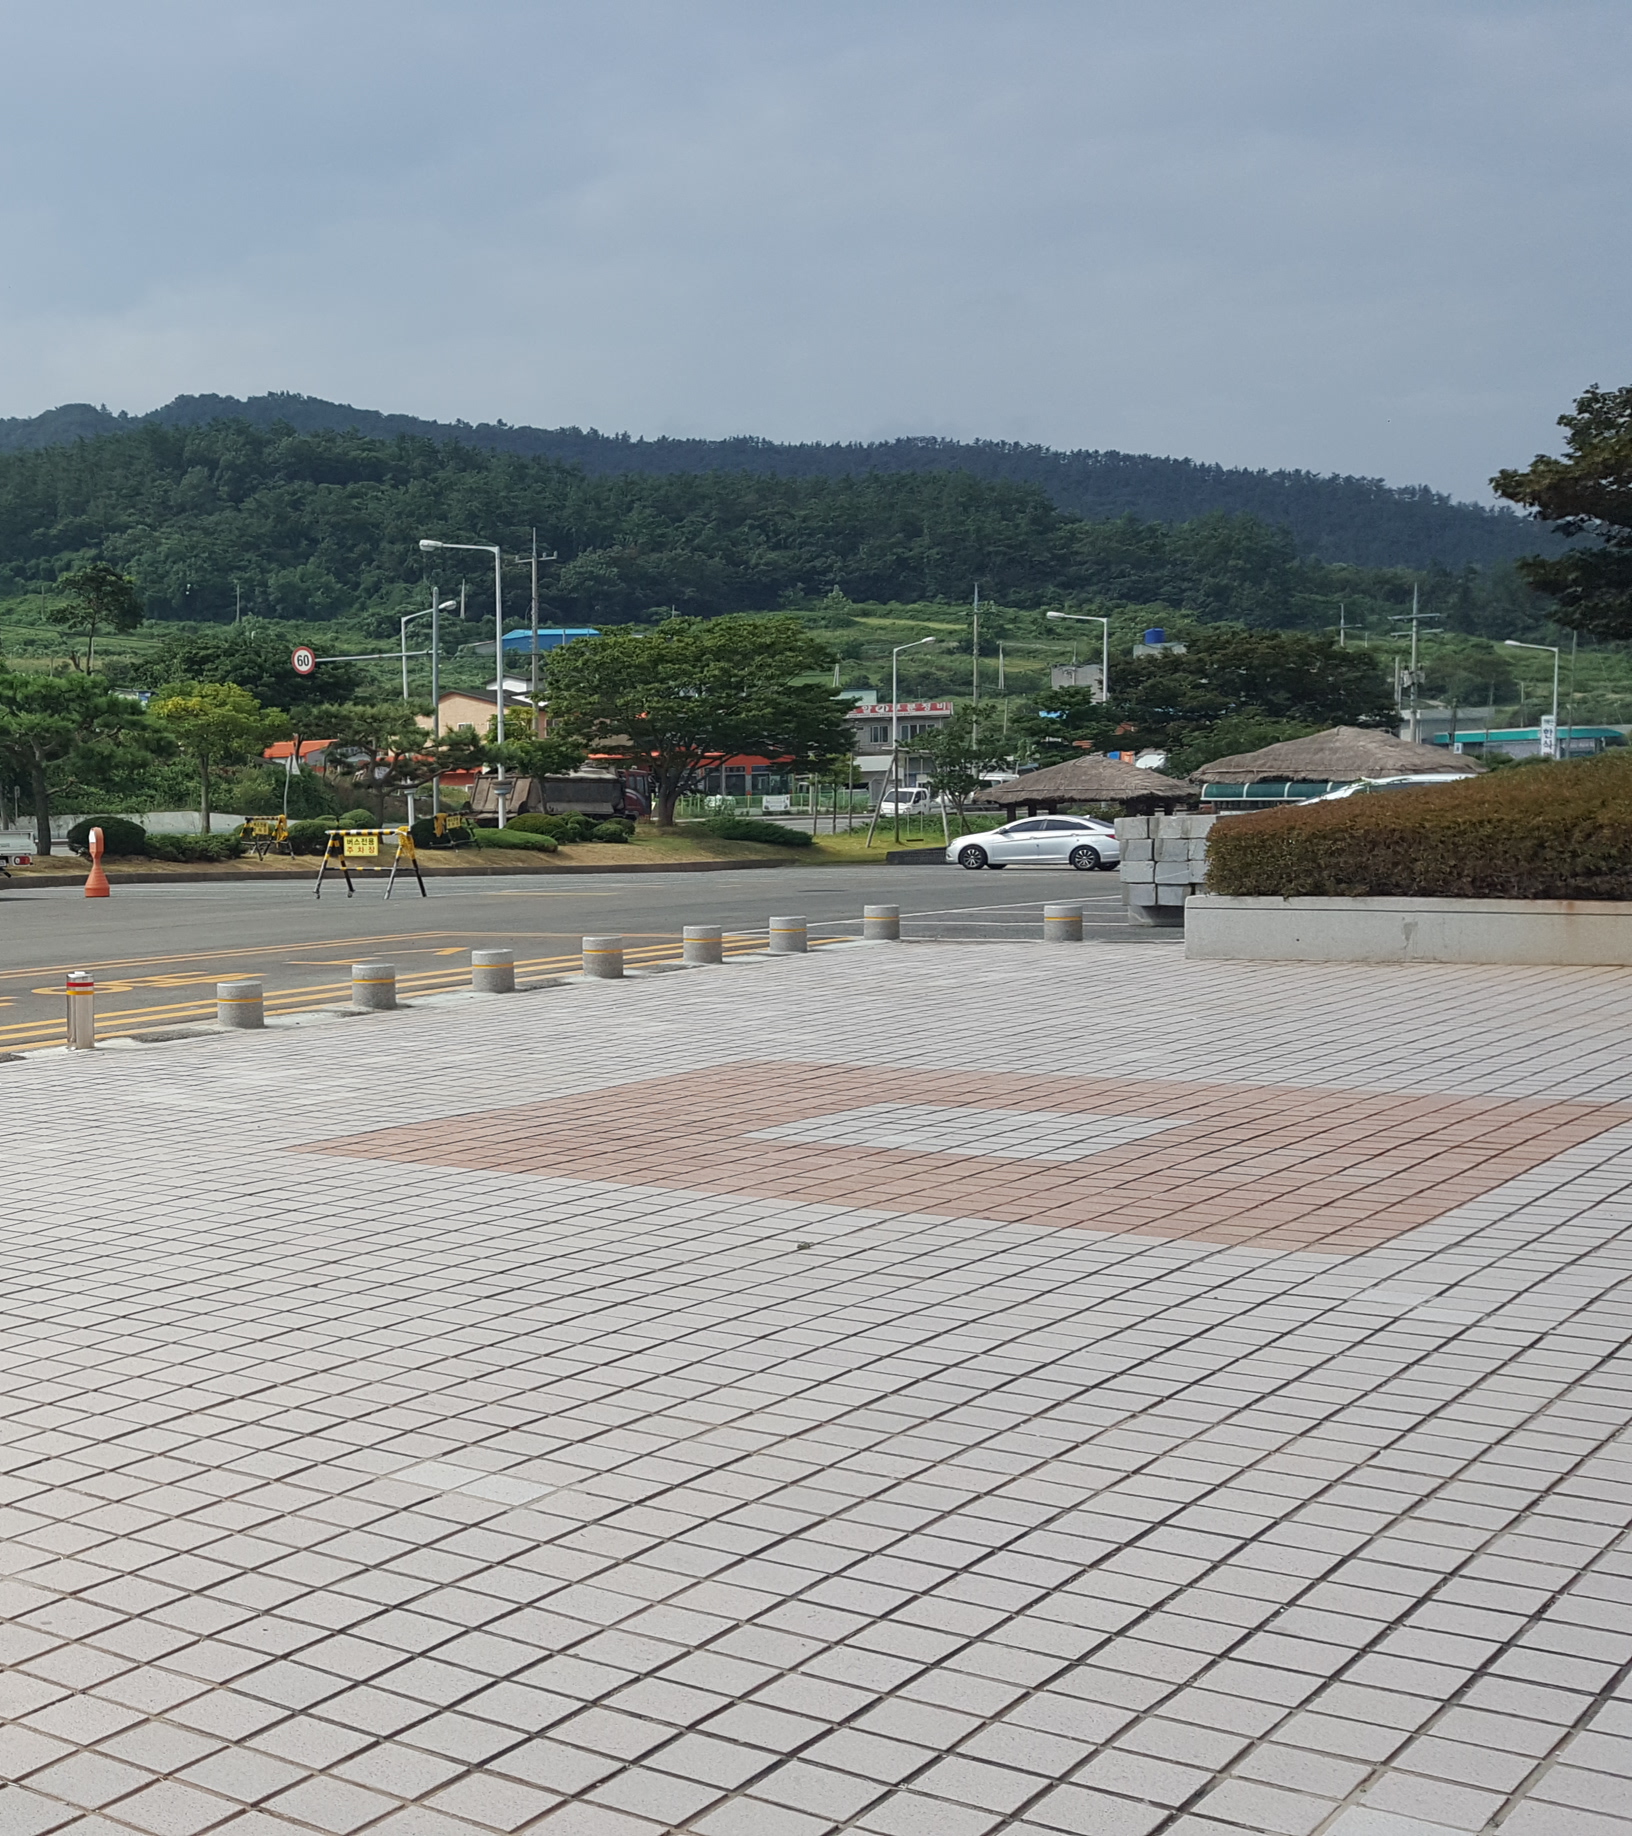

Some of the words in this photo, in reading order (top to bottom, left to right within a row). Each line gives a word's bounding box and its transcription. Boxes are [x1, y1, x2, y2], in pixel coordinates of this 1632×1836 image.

[297, 654, 310, 667] 60
[346, 837, 375, 846] 버스전용
[346, 846, 375, 854] 주차장
